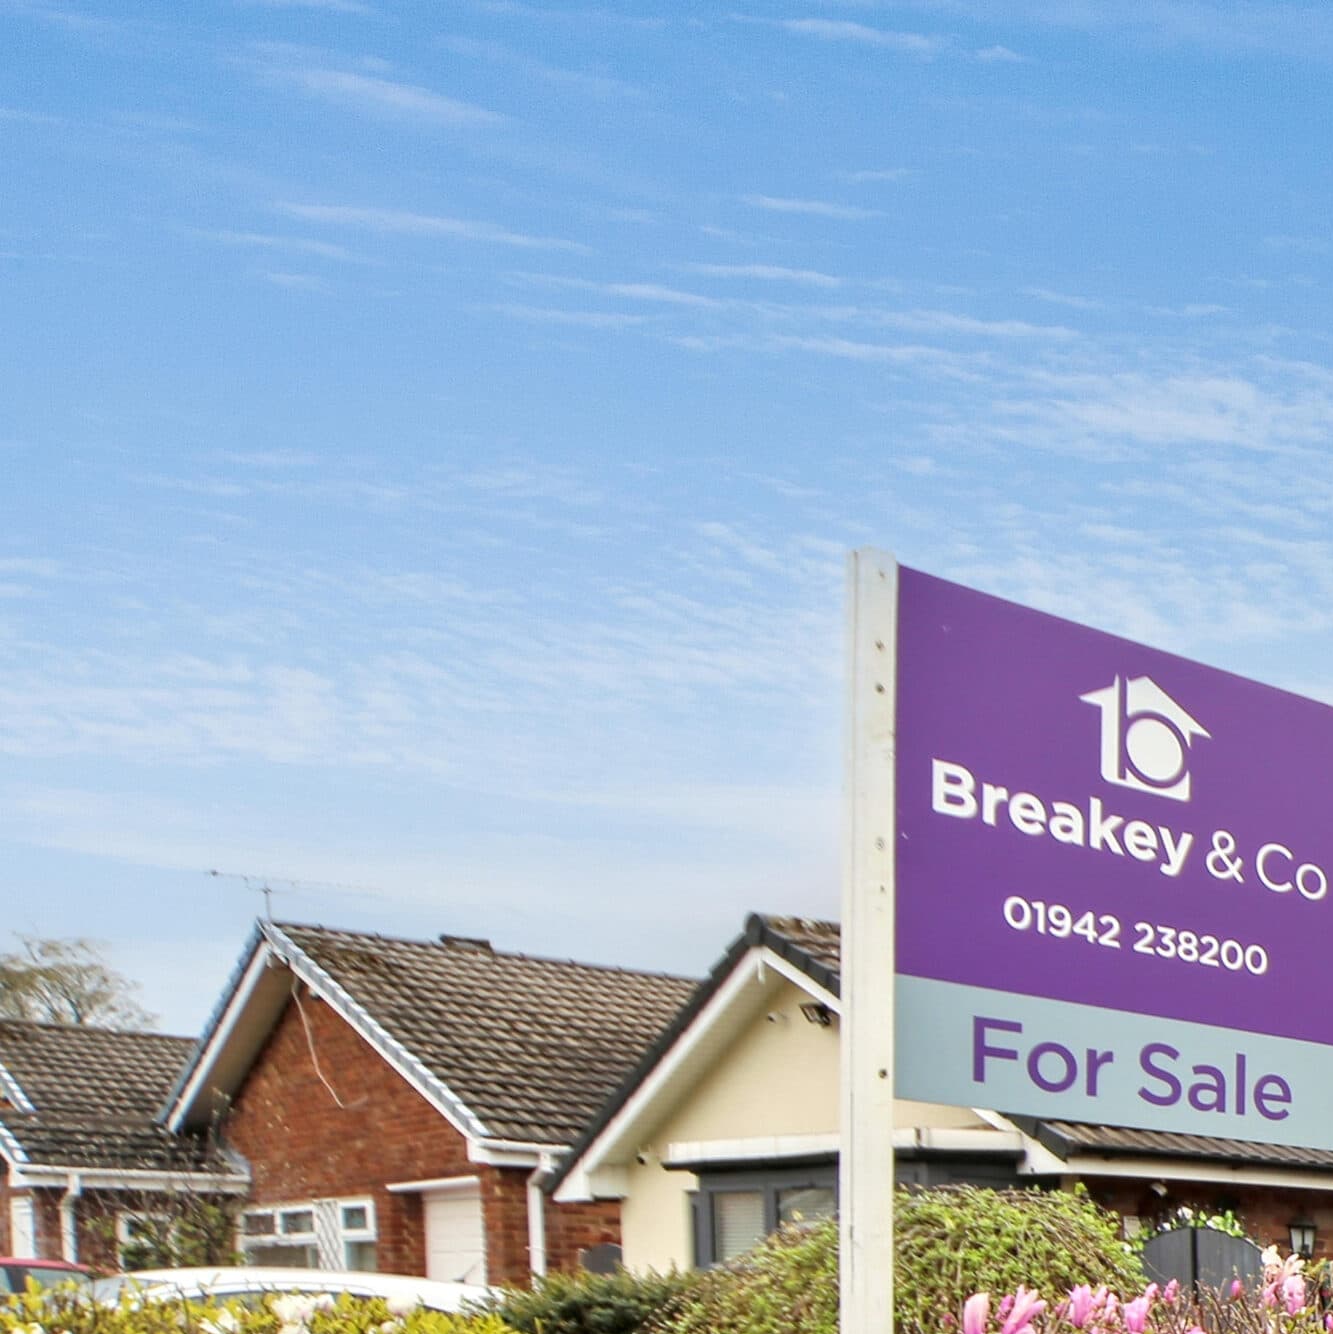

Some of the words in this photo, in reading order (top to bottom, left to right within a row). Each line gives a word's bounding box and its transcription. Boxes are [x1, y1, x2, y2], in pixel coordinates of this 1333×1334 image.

[931, 758, 1195, 877] Breakey
[1205, 830, 1245, 885] &
[1255, 843, 1328, 901] Co
[1003, 896, 1122, 949] 01942
[1133, 922, 1269, 976] 238200
[973, 1015, 1114, 1098] For
[1138, 1043, 1293, 1121] Sale
